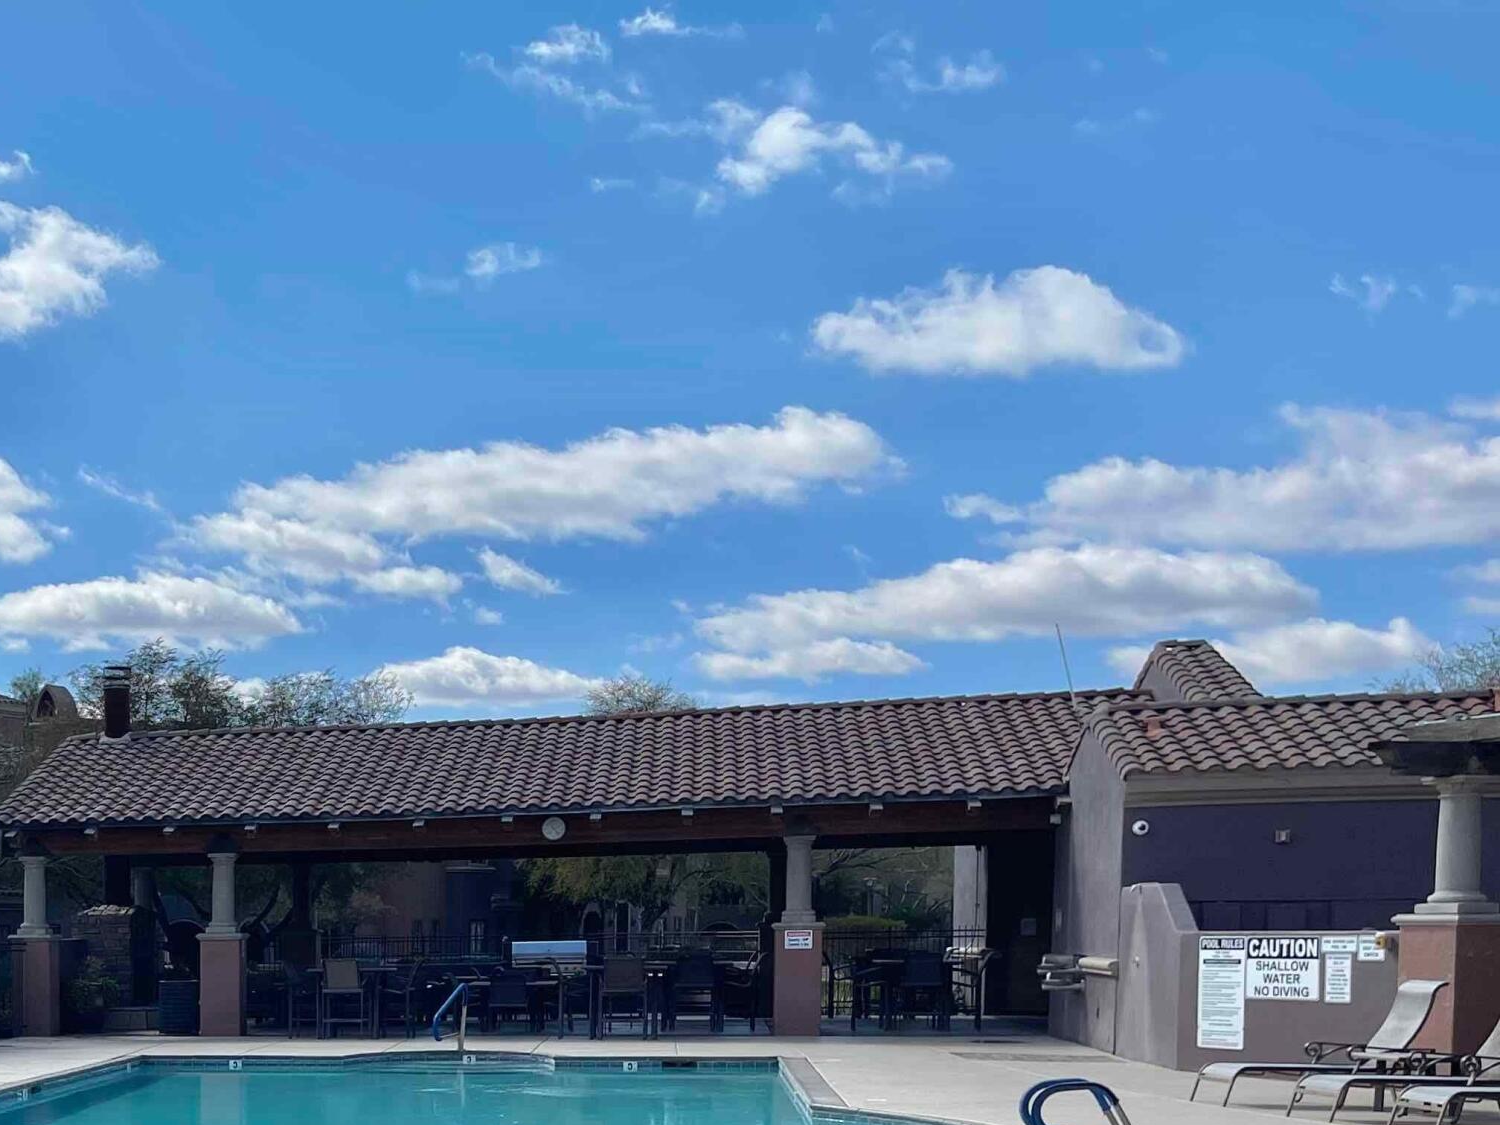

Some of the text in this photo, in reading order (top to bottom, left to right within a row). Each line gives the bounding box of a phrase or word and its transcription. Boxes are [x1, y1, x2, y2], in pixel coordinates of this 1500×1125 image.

[1202, 939, 1244, 949] POOL RULES
[1248, 938, 1318, 957] CAUTION
[1255, 960, 1309, 971] SHALLOW
[1262, 973, 1300, 984] WATER
[1254, 986, 1309, 997] NO DIVING
